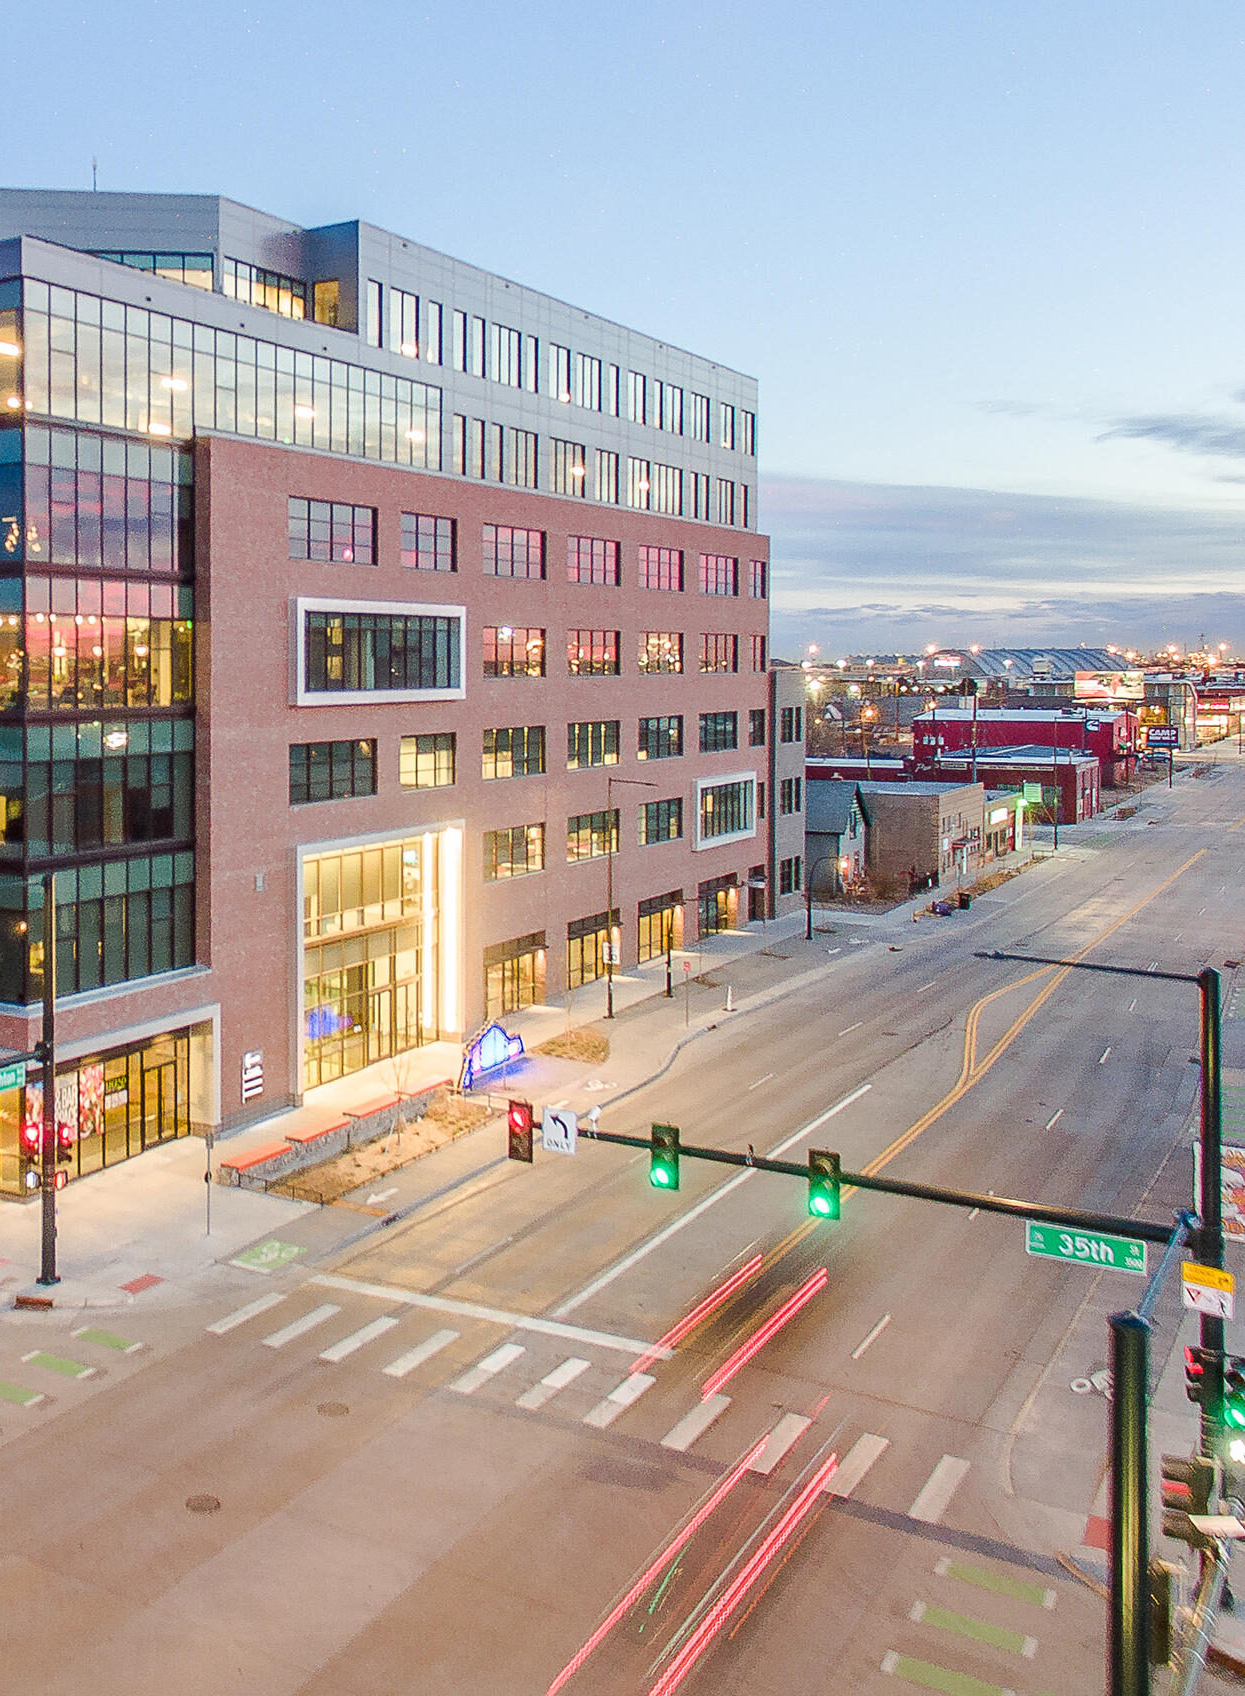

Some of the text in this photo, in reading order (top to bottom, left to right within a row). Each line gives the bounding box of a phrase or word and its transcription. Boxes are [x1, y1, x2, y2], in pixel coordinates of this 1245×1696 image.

[1148, 728, 1177, 737] CAMP
[546, 1138, 571, 1150] ONLY
[1058, 1233, 1115, 1263] 35th
